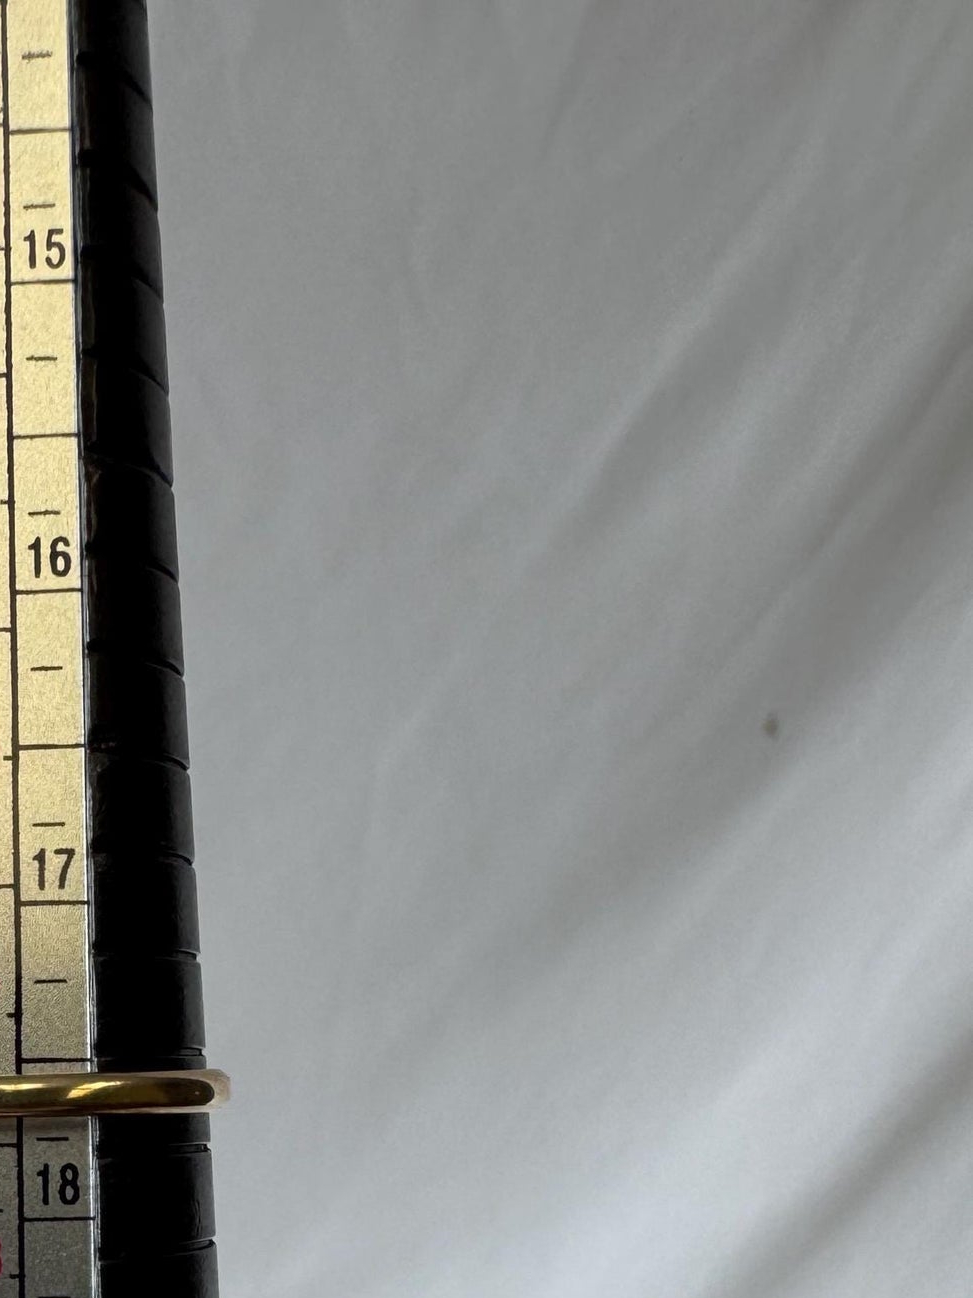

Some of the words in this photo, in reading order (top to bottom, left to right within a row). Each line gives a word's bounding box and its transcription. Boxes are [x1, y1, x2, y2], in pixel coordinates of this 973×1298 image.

[23, 228, 66, 270] 15
[27, 535, 72, 579] 16
[32, 847, 76, 891] 17
[36, 1162, 81, 1206] 18
